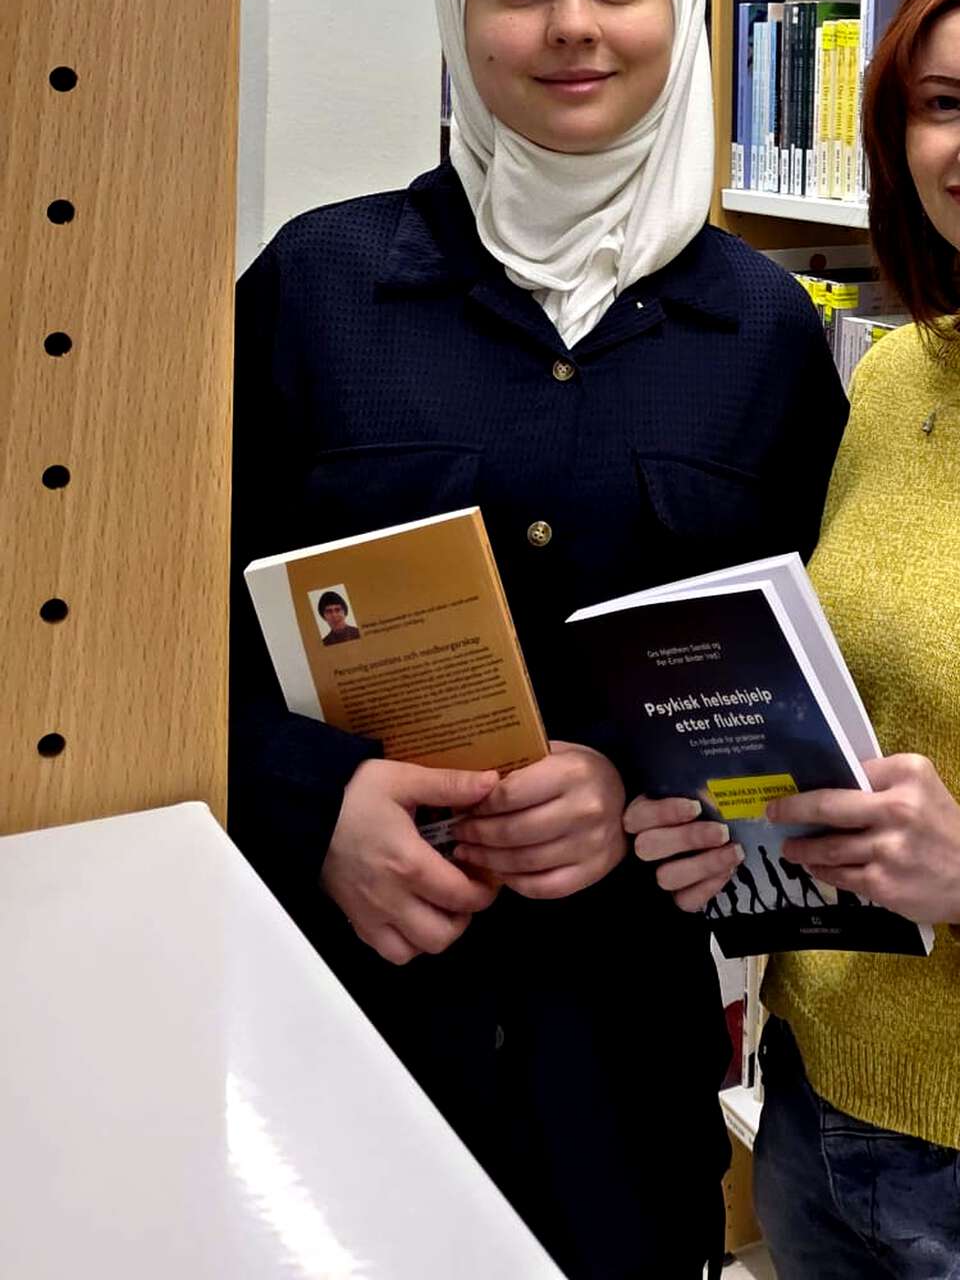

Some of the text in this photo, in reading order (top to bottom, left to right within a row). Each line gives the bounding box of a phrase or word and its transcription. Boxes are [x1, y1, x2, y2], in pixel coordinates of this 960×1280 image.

[403, 650, 418, 661] och
[644, 688, 773, 717] Psykisk helsehjelp
[675, 713, 764, 733] etter flukten
